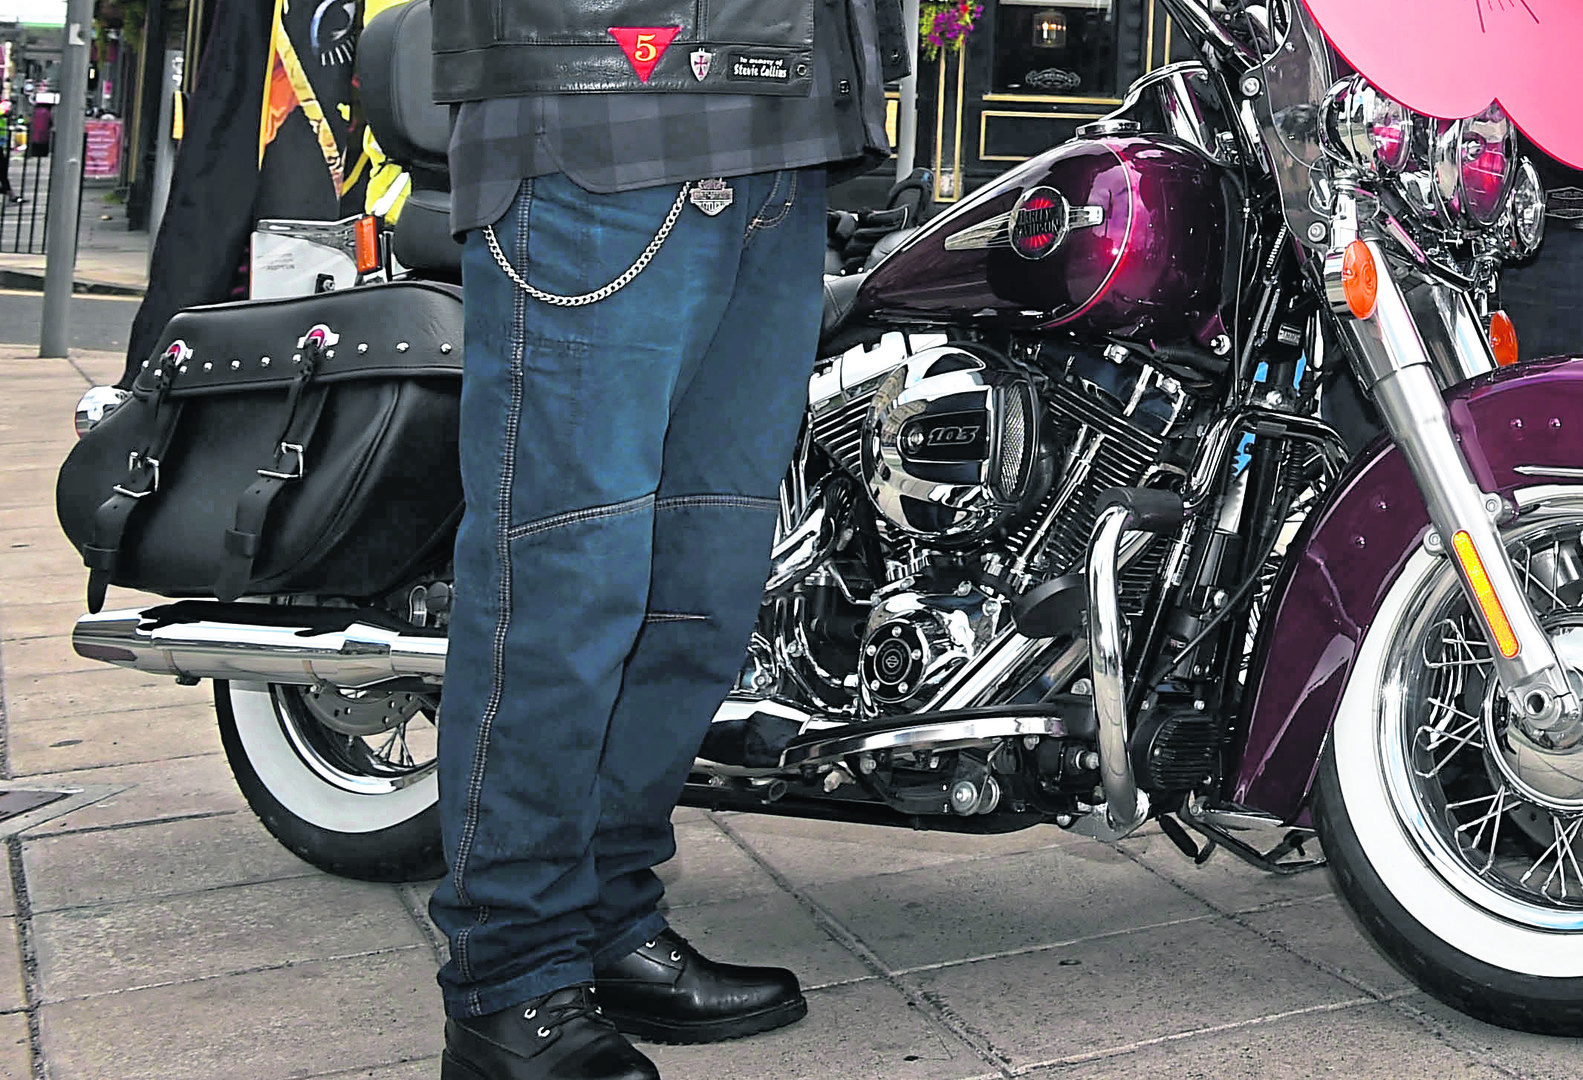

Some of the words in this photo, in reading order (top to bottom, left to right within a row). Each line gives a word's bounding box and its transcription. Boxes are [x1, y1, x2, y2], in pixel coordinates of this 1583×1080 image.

[634, 34, 657, 61] 5
[733, 63, 759, 77] Stevie
[760, 64, 787, 78] Collins
[926, 426, 981, 446] 103
